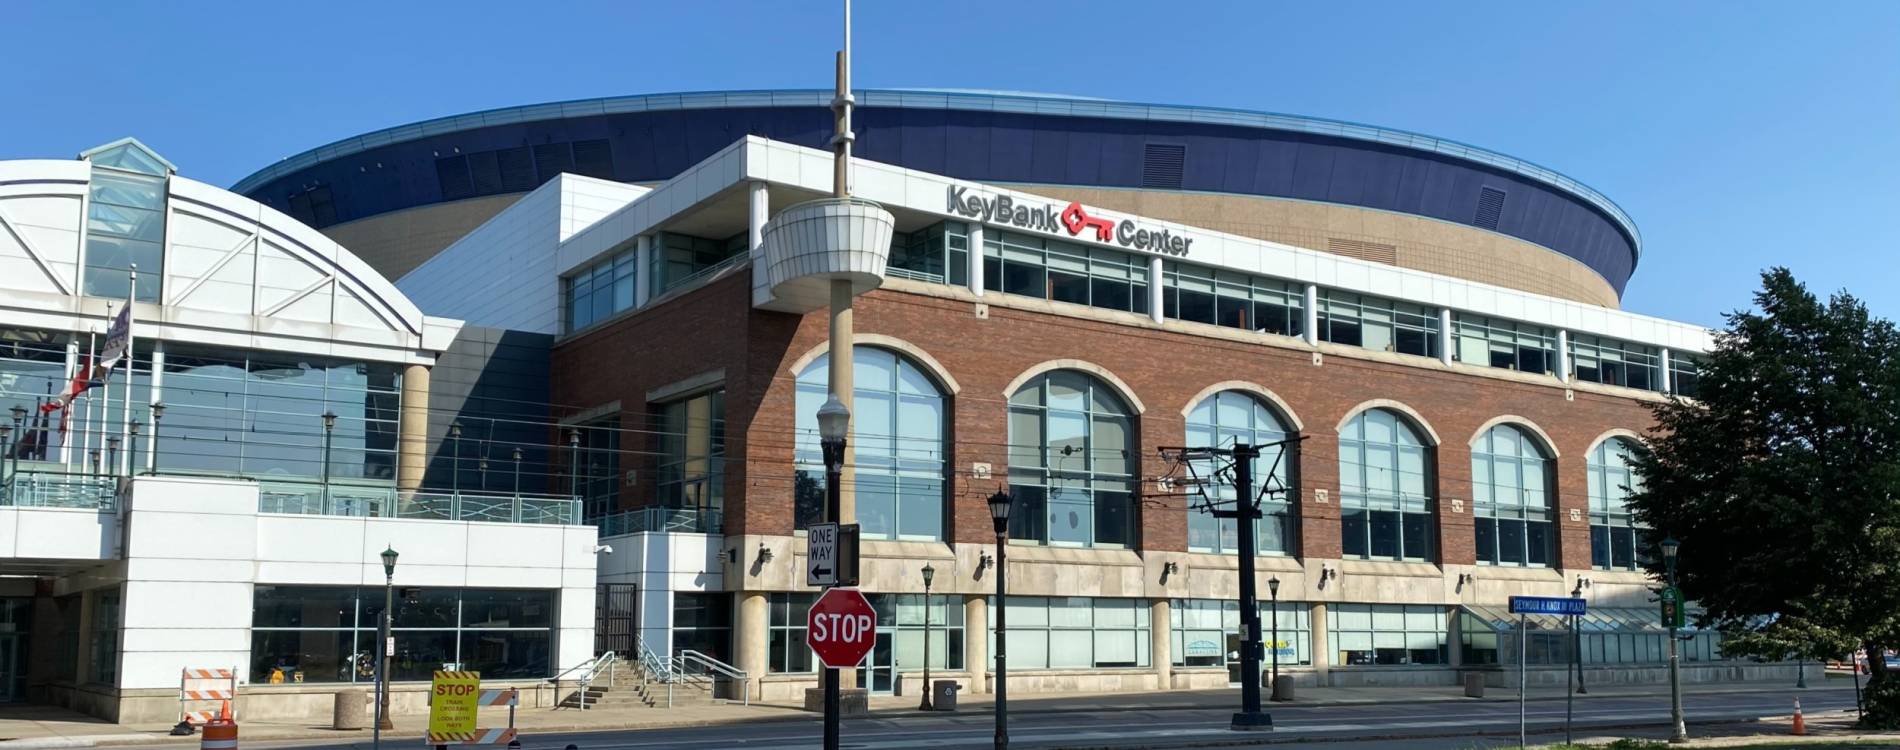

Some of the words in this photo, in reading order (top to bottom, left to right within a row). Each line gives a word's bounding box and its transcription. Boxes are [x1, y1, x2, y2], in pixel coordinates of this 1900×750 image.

[947, 184, 1061, 233] KeyBank
[1116, 219, 1193, 256] Center
[811, 529, 833, 543] ONE
[811, 546, 832, 560] WAY
[1546, 600, 1560, 611] KNOX
[1569, 601, 1585, 612] PLAZA
[813, 613, 872, 643] STOP
[436, 684, 475, 696] STOP
